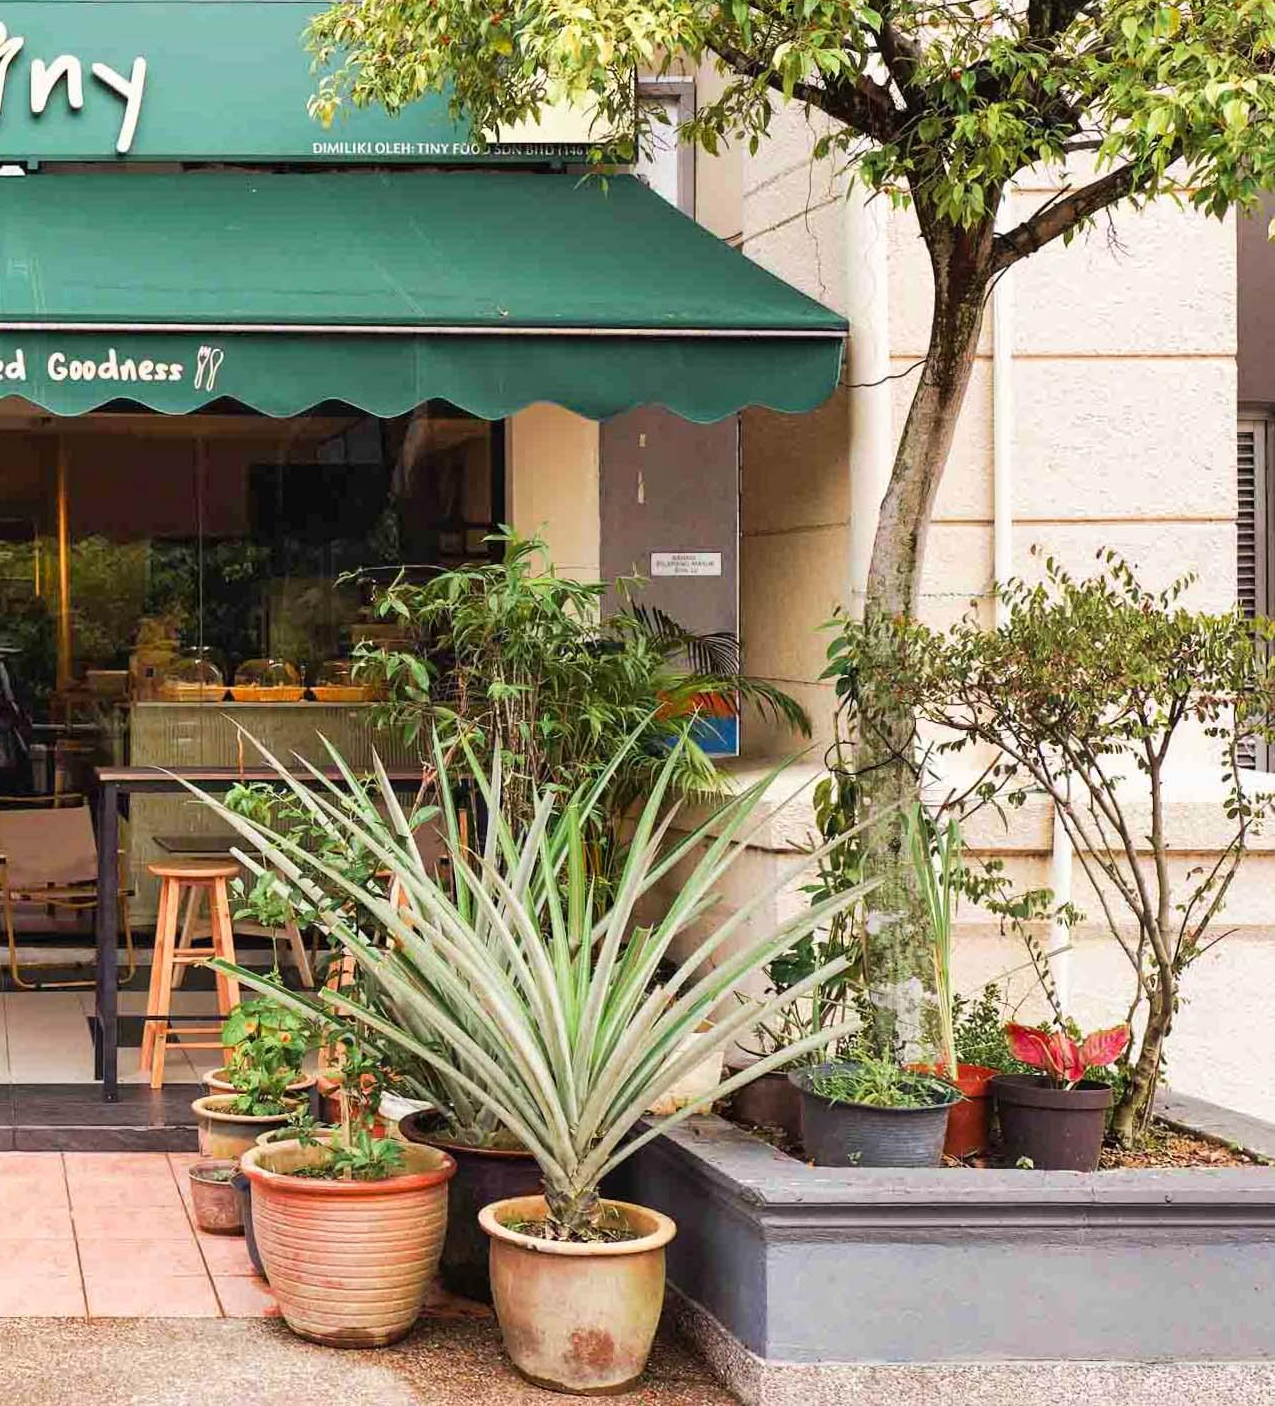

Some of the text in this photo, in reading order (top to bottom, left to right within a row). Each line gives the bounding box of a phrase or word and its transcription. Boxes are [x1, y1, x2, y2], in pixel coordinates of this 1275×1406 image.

[312, 141, 372, 155] DIMILIKI
[374, 141, 415, 155] OLEH:
[416, 142, 449, 155] TINY
[46, 348, 185, 382] Goodness
